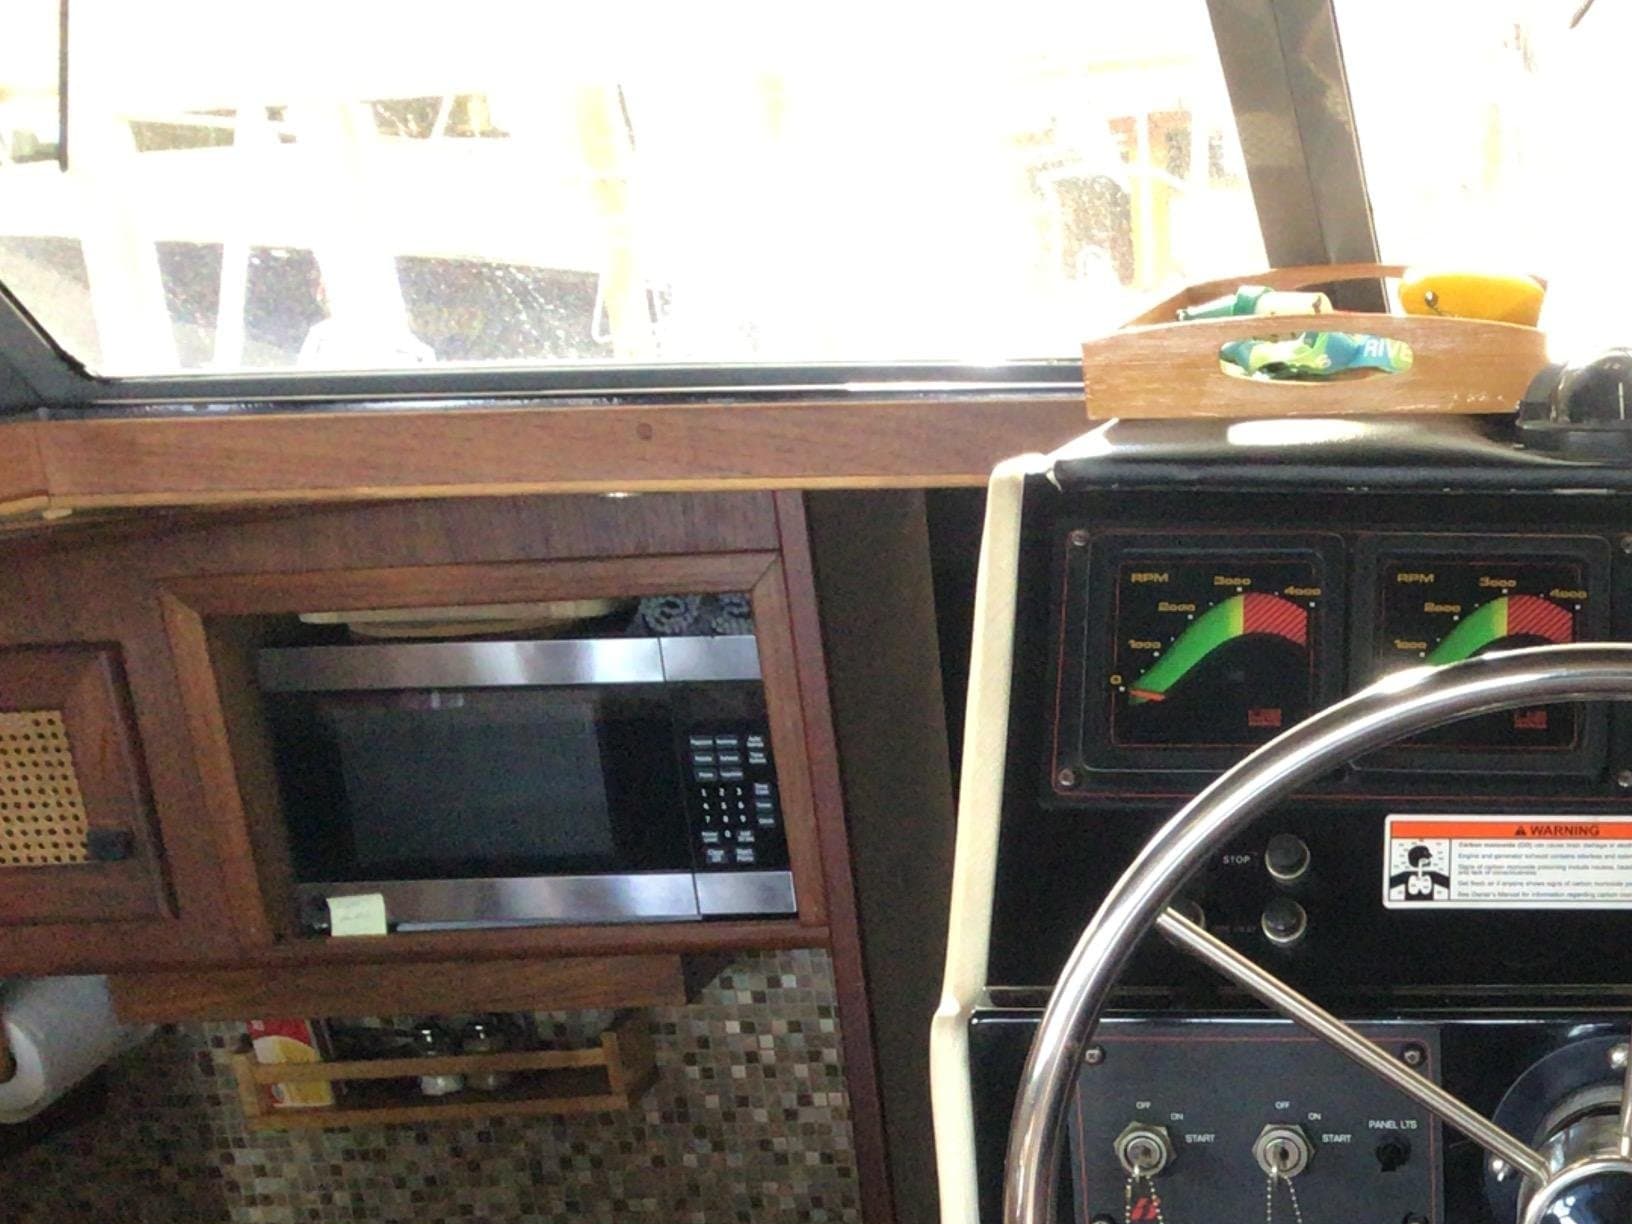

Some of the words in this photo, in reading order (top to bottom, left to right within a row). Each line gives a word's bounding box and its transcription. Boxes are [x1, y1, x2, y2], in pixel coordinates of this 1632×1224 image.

[1130, 572, 1169, 583] RPM
[1396, 573, 1435, 583] RPM
[1478, 577, 1517, 587] 3000
[1284, 586, 1322, 596] 4000
[1549, 589, 1588, 599] 4000
[1128, 639, 1162, 650] 1000
[1394, 639, 1427, 650] 1000
[1530, 825, 1600, 836] WARNING
[1222, 855, 1251, 864] STOP
[1136, 1101, 1152, 1110] OFF
[1275, 1101, 1291, 1110] OFF
[1171, 1112, 1184, 1121] ON
[1308, 1112, 1322, 1121] ON
[1368, 1119, 1398, 1130] PANEL
[1401, 1119, 1418, 1130] LTS
[1185, 1134, 1215, 1143] START
[1322, 1134, 1352, 1143] START
